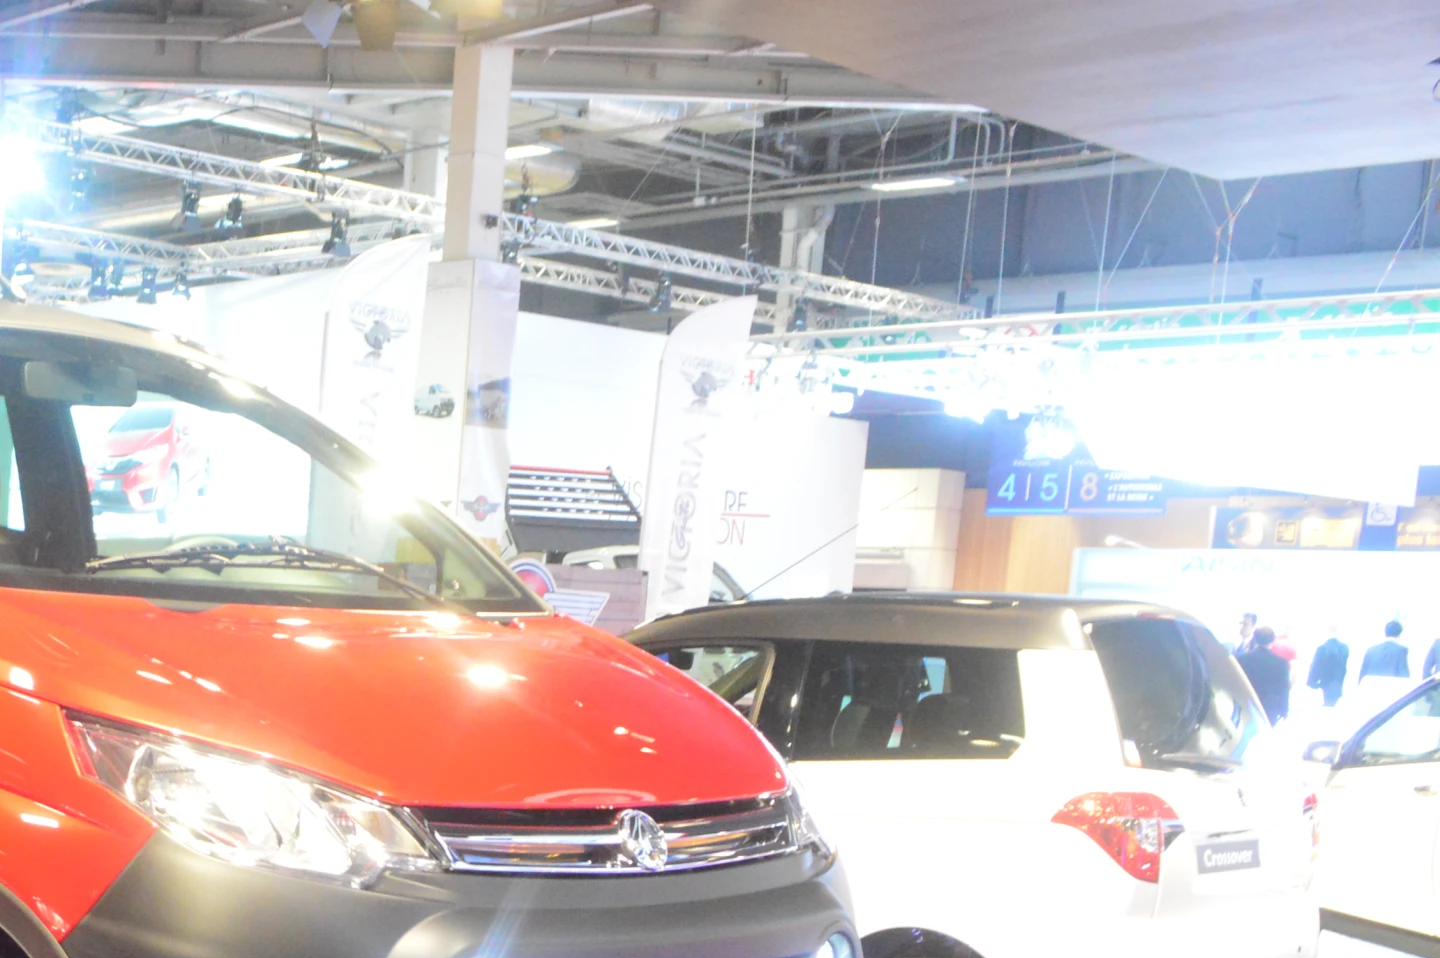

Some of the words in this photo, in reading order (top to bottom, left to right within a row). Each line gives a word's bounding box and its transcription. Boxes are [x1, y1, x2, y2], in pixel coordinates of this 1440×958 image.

[998, 473, 1016, 500] 4
[1040, 474, 1058, 501] 5
[1080, 472, 1098, 501] 8
[1203, 849, 1253, 868] Crossover
